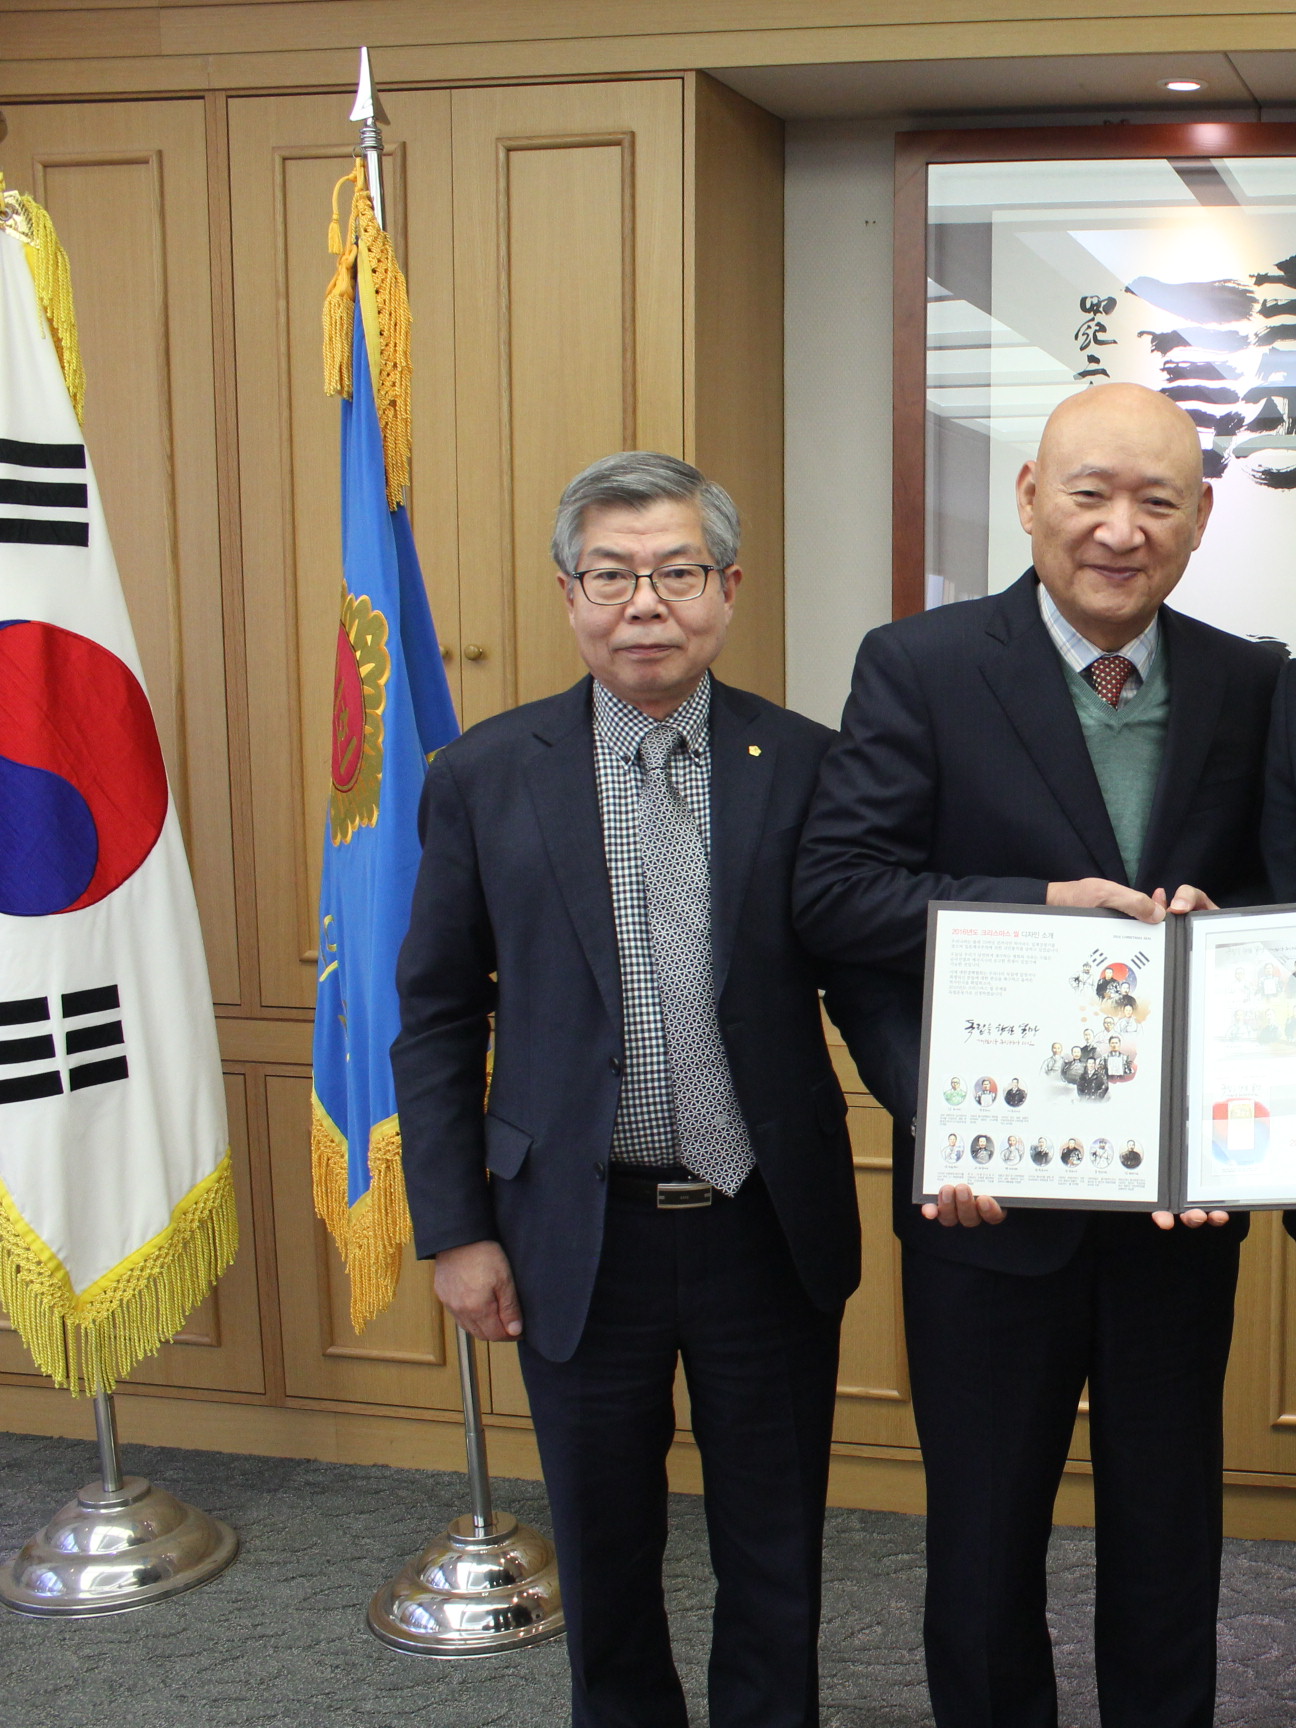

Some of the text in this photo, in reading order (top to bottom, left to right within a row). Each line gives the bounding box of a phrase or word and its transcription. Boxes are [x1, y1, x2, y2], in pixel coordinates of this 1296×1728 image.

[951, 928, 979, 936] 2016년도
[980, 929, 1011, 937] 크리스마스
[1021, 931, 1040, 939] 디자인
[1041, 931, 1054, 940] 소개
